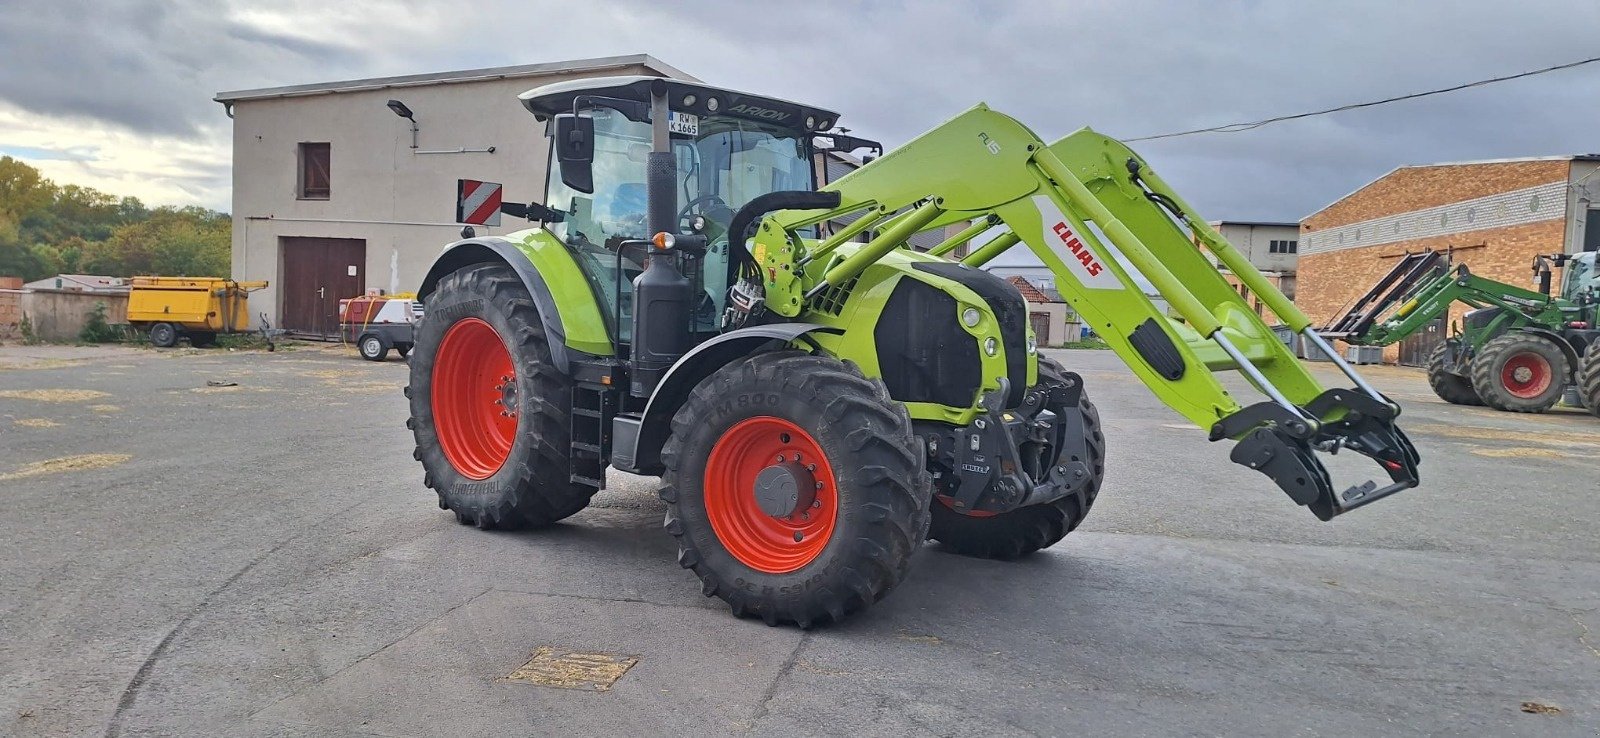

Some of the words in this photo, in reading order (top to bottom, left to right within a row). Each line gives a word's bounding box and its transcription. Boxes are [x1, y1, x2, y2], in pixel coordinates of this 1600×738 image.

[680, 113, 690, 123] RW
[728, 104, 791, 120] ARION
[670, 121, 676, 131] K
[678, 123, 697, 135] 1665
[1053, 221, 1103, 276] CLAAS
[738, 393, 780, 408] 800
